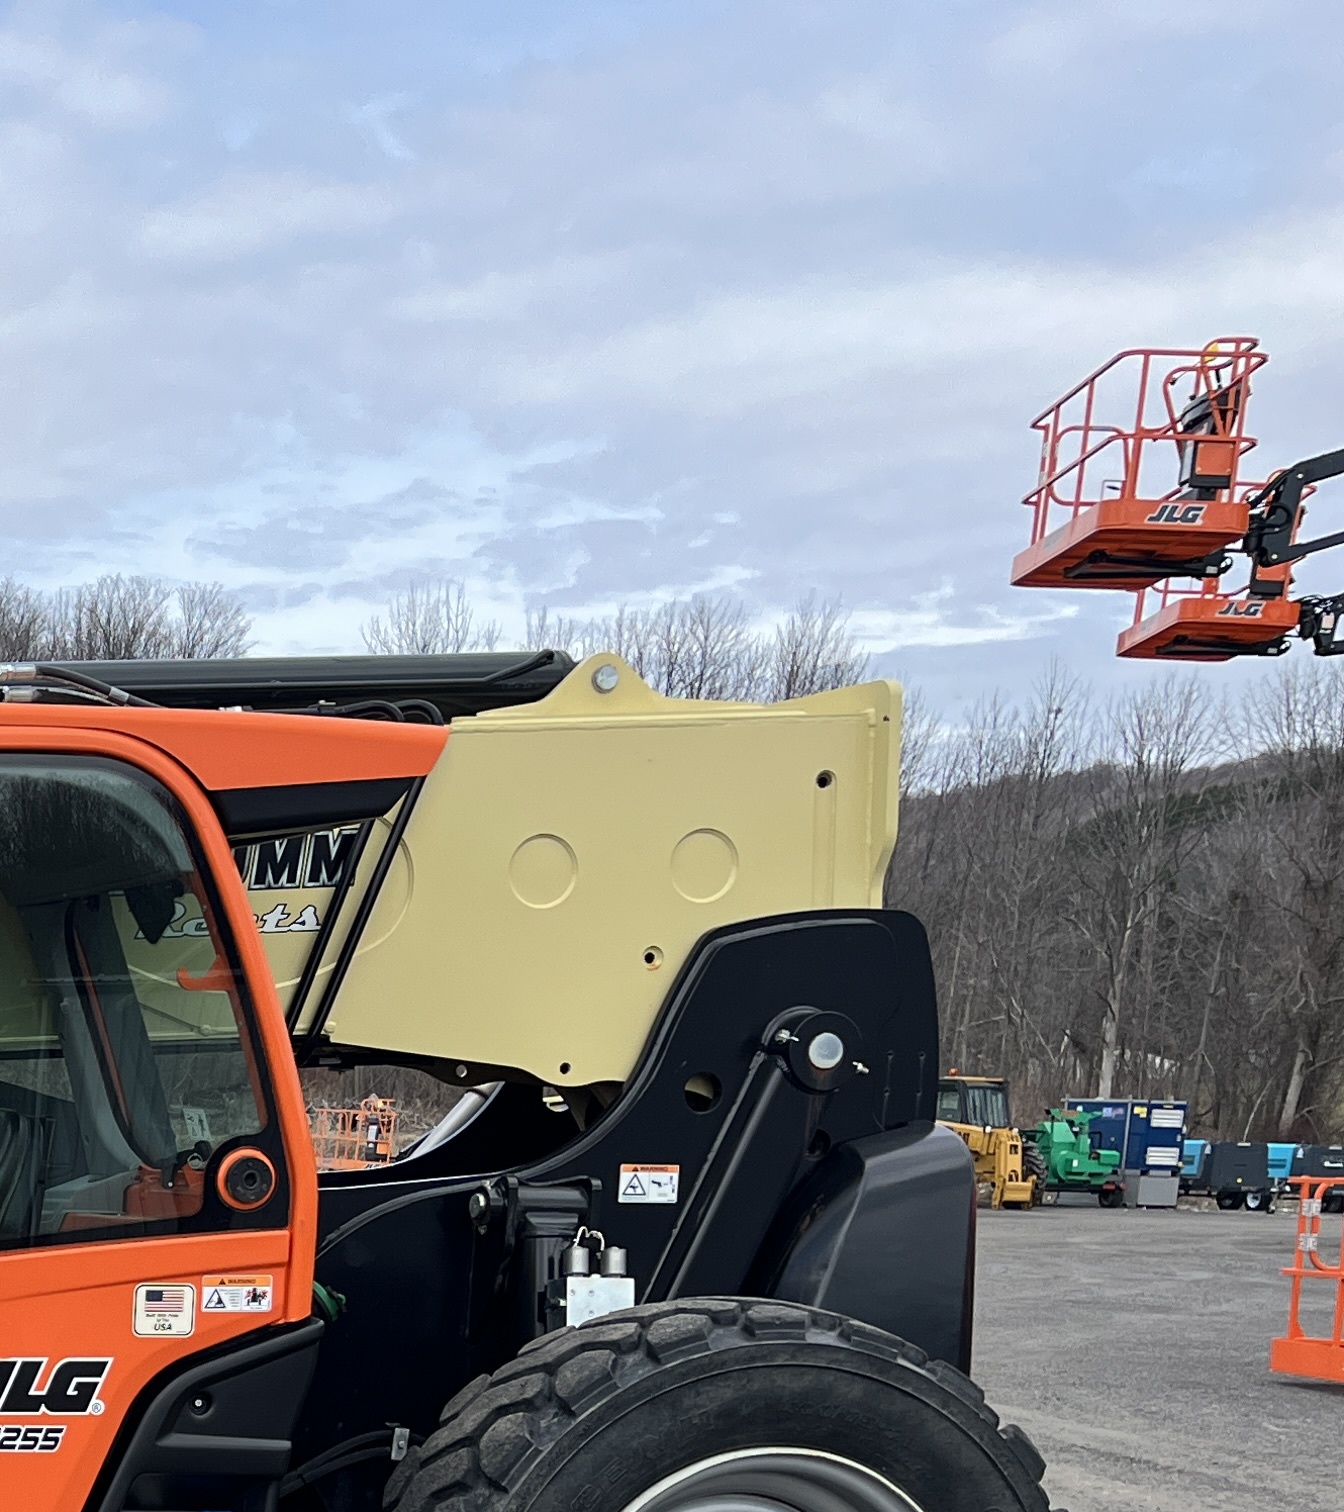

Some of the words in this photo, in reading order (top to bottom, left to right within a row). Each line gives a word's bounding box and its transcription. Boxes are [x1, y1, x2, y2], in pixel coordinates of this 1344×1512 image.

[1147, 504, 1204, 523] JLG
[1218, 602, 1261, 616] JLG
[154, 1323, 172, 1331] USA
